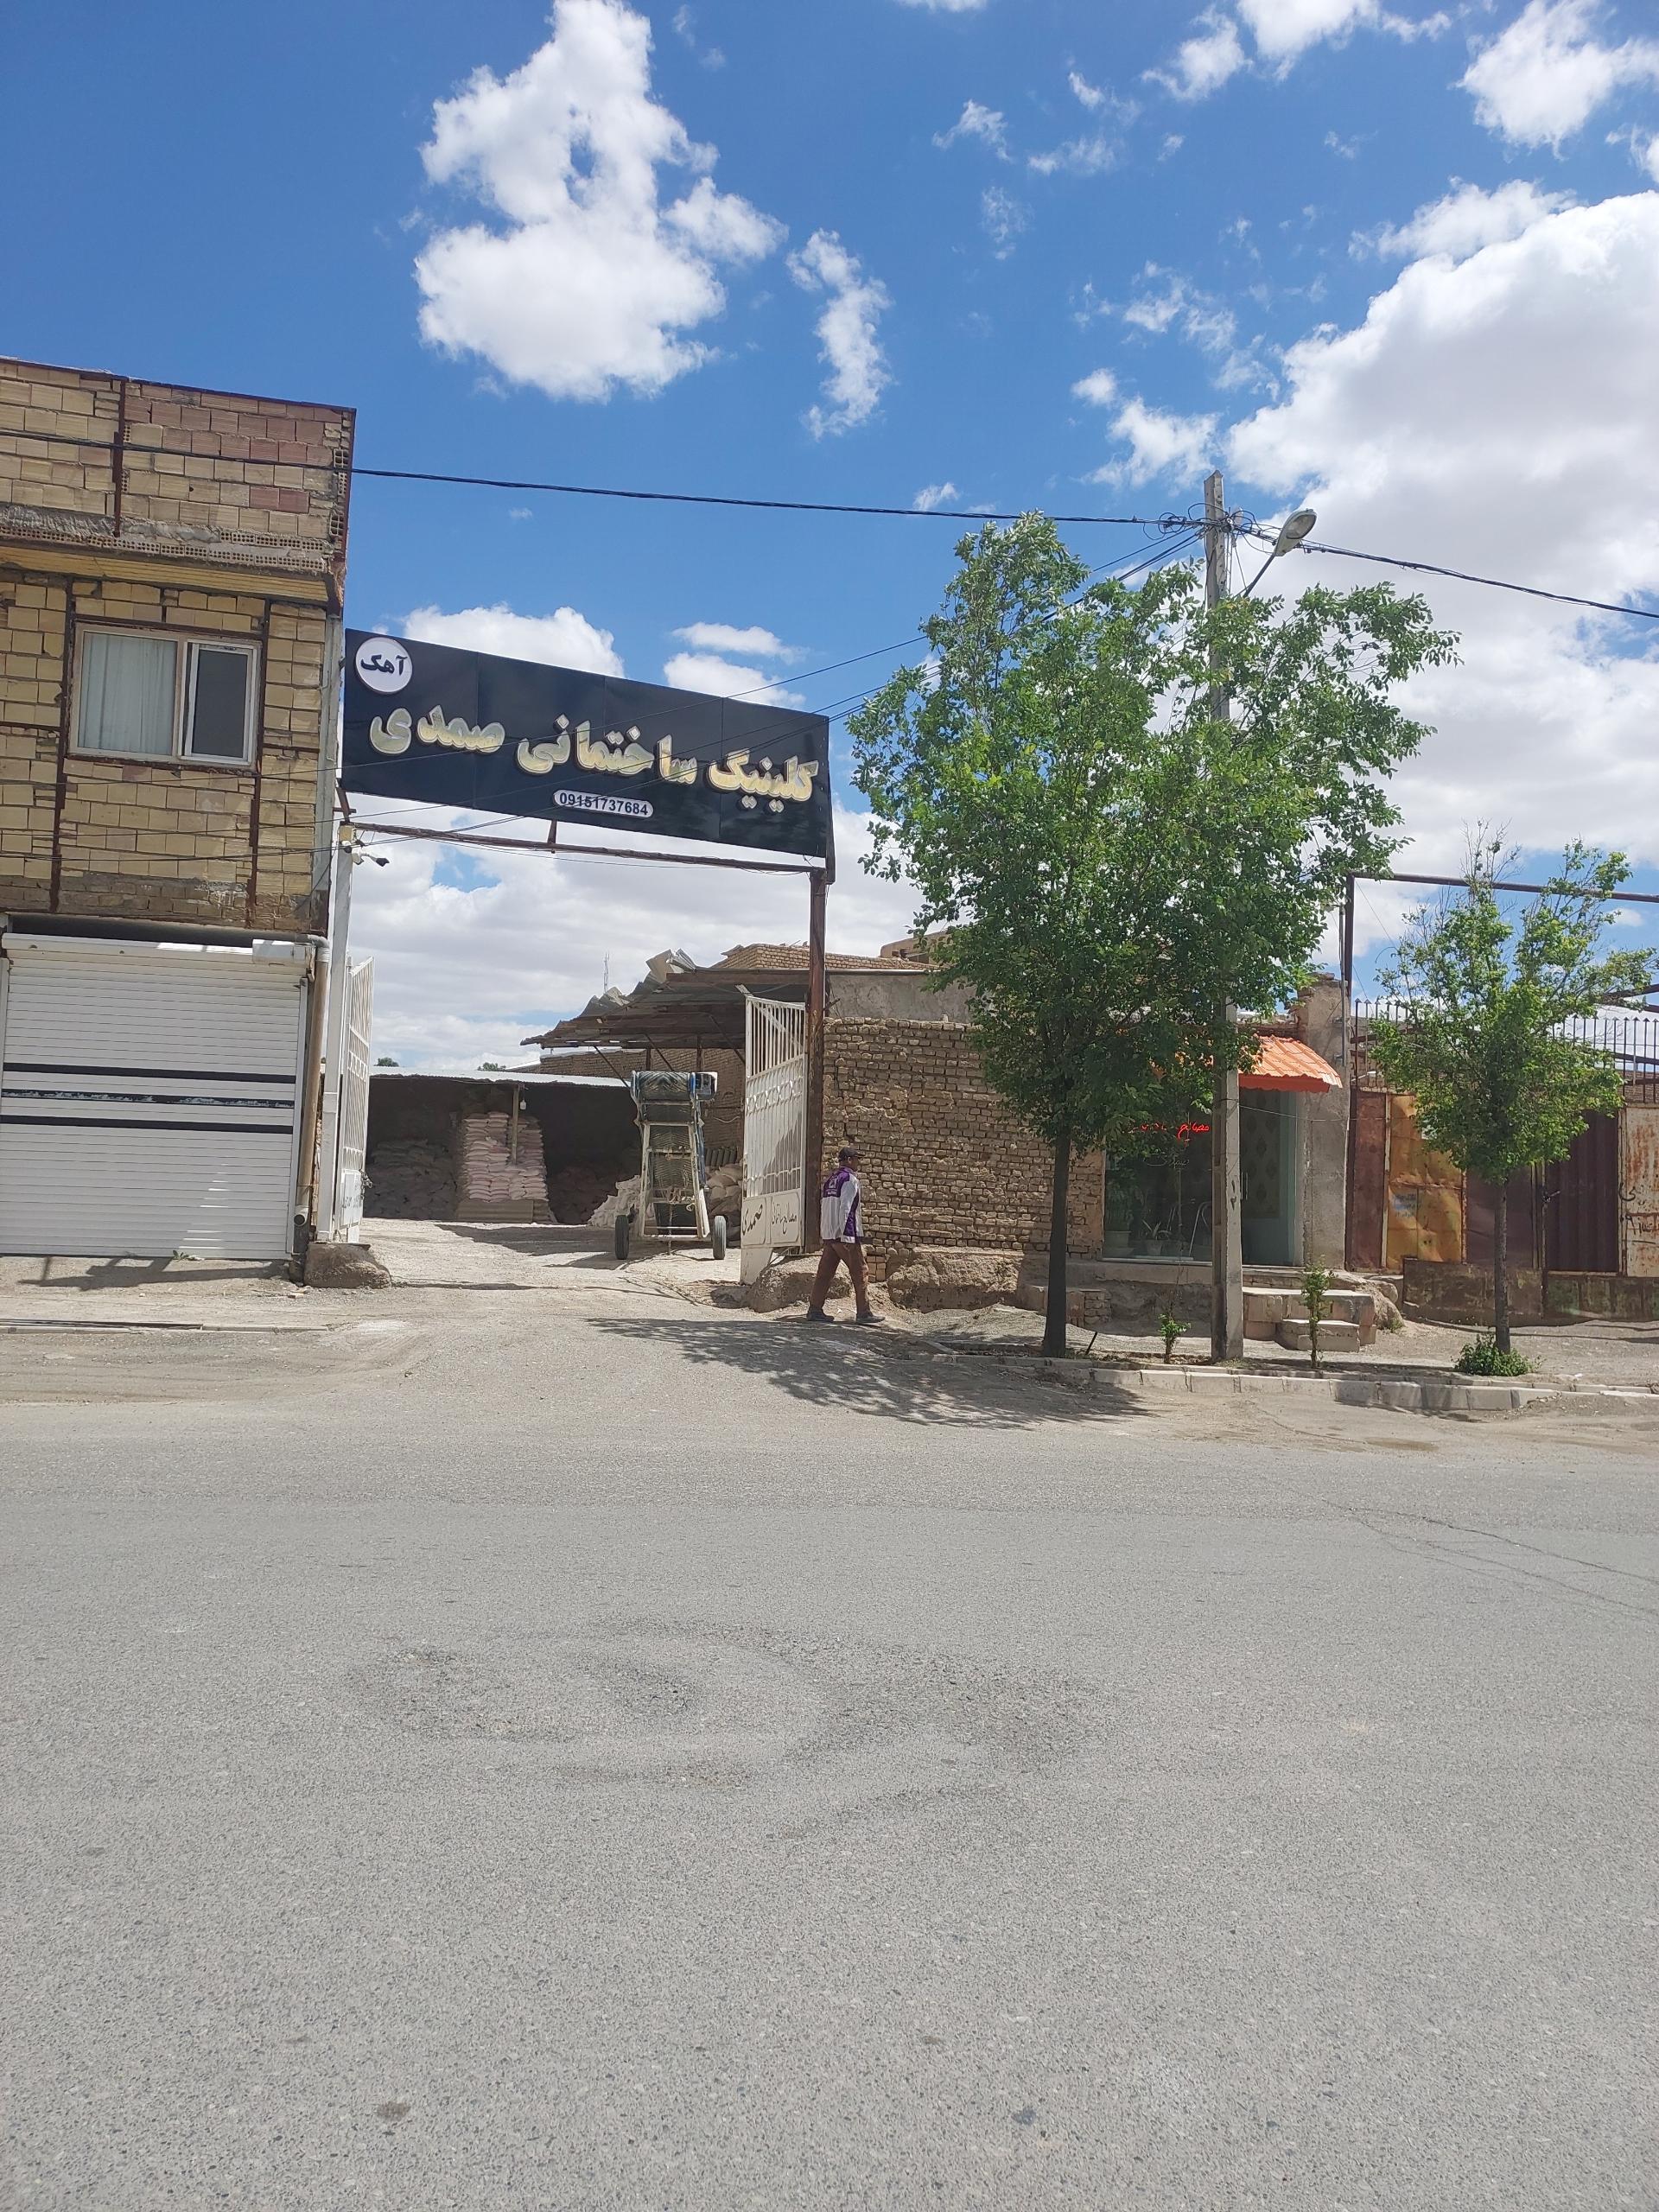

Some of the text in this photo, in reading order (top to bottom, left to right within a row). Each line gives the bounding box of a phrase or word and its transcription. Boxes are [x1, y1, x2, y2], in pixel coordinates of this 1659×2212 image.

[359, 654, 409, 676] آهک
[369, 703, 506, 755] صمدی
[516, 714, 698, 785] ساختمانی
[559, 792, 648, 815] 09151737684
